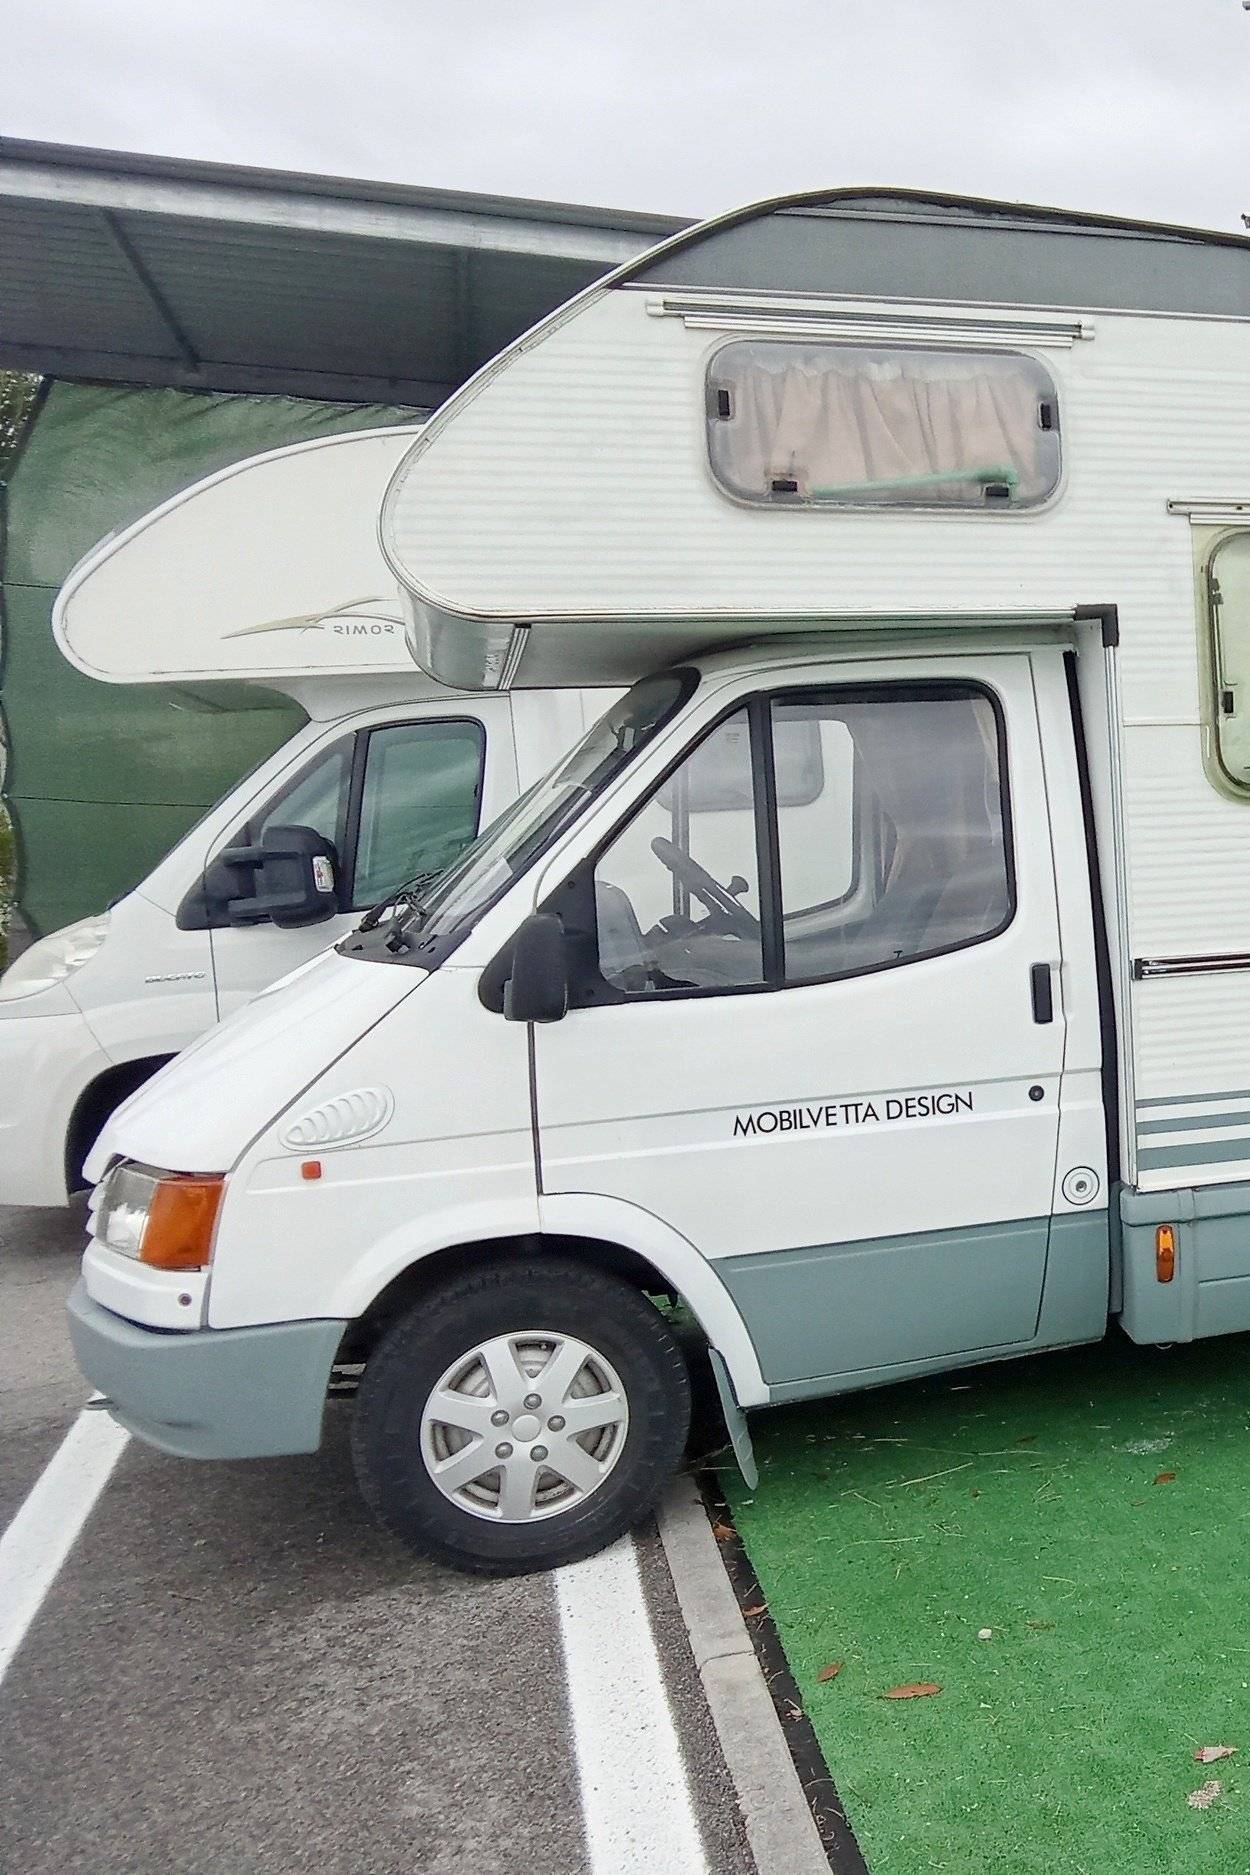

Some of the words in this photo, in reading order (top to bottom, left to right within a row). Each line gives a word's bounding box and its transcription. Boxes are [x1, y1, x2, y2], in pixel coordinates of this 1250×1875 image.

[333, 624, 395, 635] RIMOR
[733, 1101, 880, 1137] MOBILVETTA
[886, 1091, 974, 1120] DESIGN
